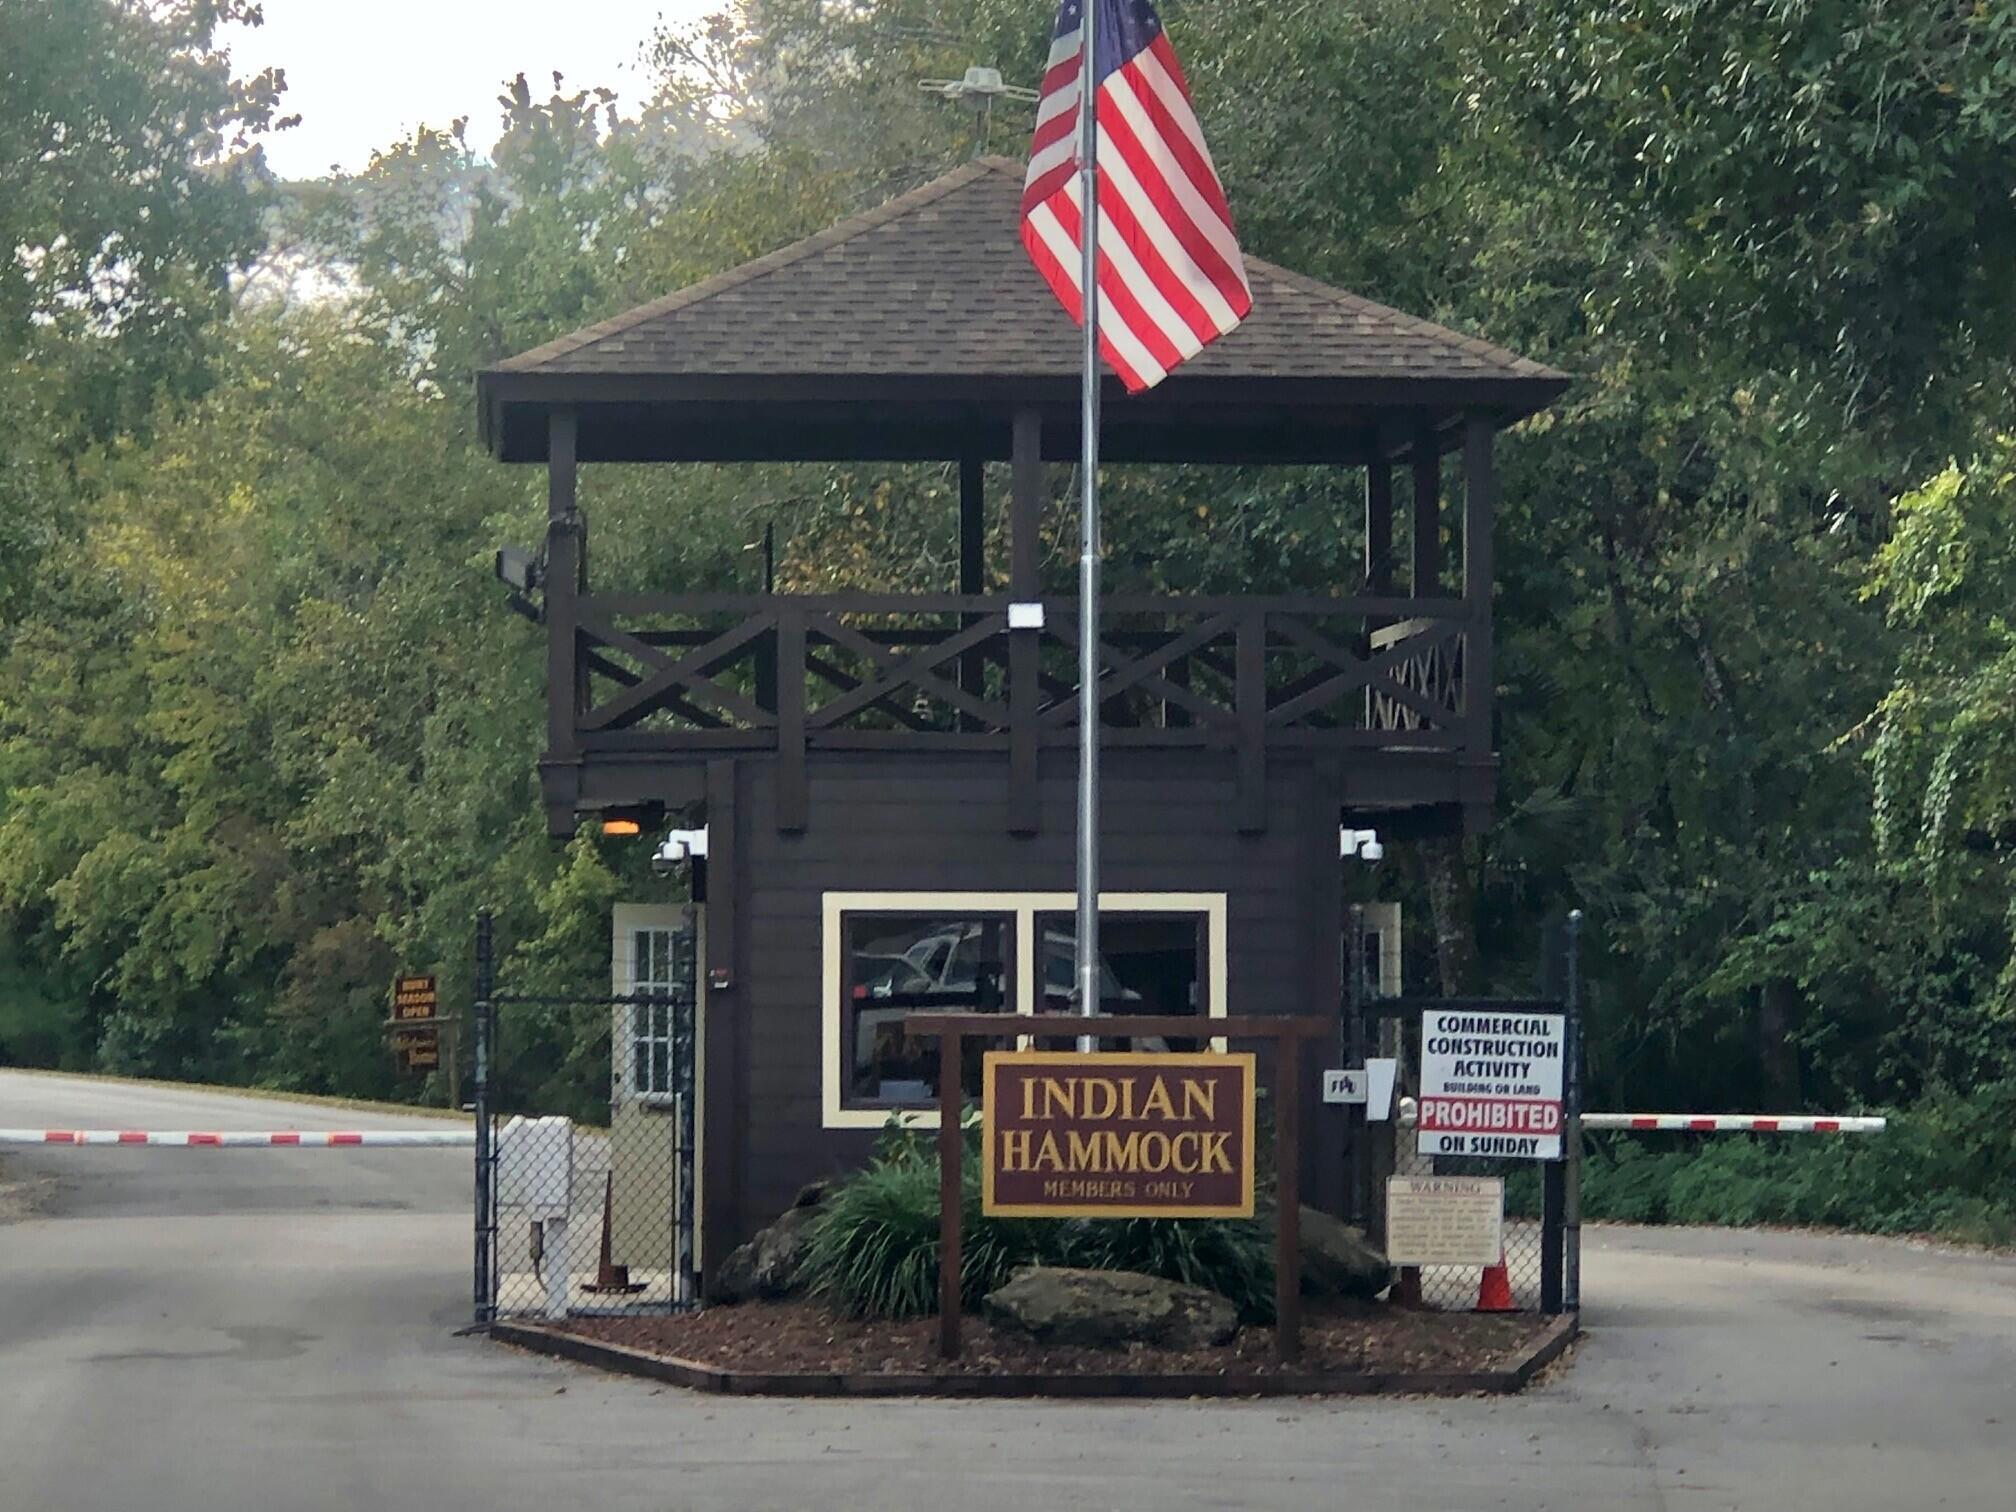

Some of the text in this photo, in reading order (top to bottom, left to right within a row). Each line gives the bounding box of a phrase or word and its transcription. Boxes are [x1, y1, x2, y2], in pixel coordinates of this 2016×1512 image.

[1437, 1016, 1551, 1037] COMMERCIAL
[1427, 1038, 1559, 1058] CONSTRUCTION
[1453, 1060, 1531, 1079] ACTIVITY
[1019, 1075, 1218, 1121] INDIAN
[1443, 1082, 1541, 1095] BUILDING OR LAND
[1421, 1101, 1559, 1130] PROHIBITED
[1001, 1130, 1234, 1174] HAMMOCK
[1440, 1136, 1540, 1155] ON SUNDAY
[1044, 1180, 1194, 1198] MEMBERS ONLY
[1410, 1181, 1482, 1194] WARNING
